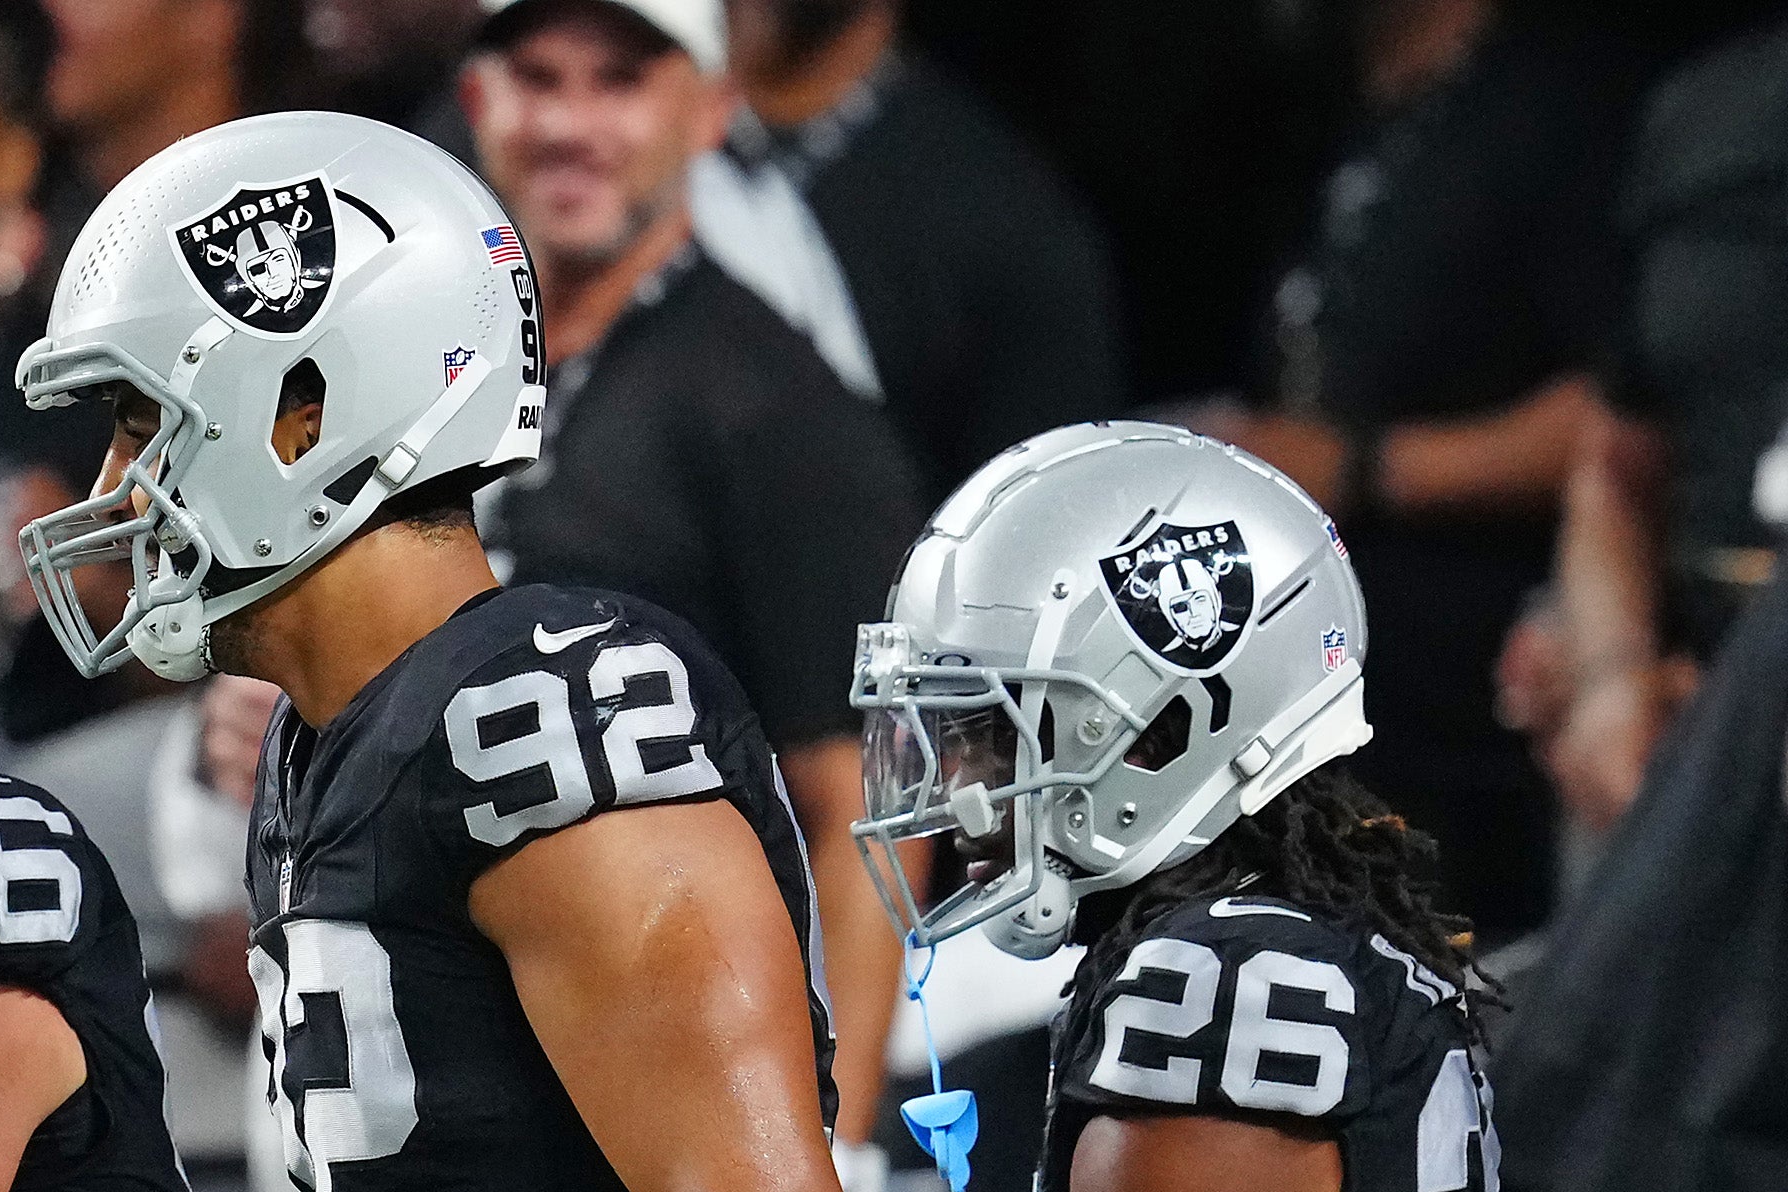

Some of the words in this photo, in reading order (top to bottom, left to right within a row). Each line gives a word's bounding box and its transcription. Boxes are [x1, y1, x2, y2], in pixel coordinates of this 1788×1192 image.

[190, 184, 311, 243] RAIDERS
[1114, 526, 1229, 574] RAIDERS
[442, 642, 724, 848] 92
[1088, 937, 1356, 1117] 26
